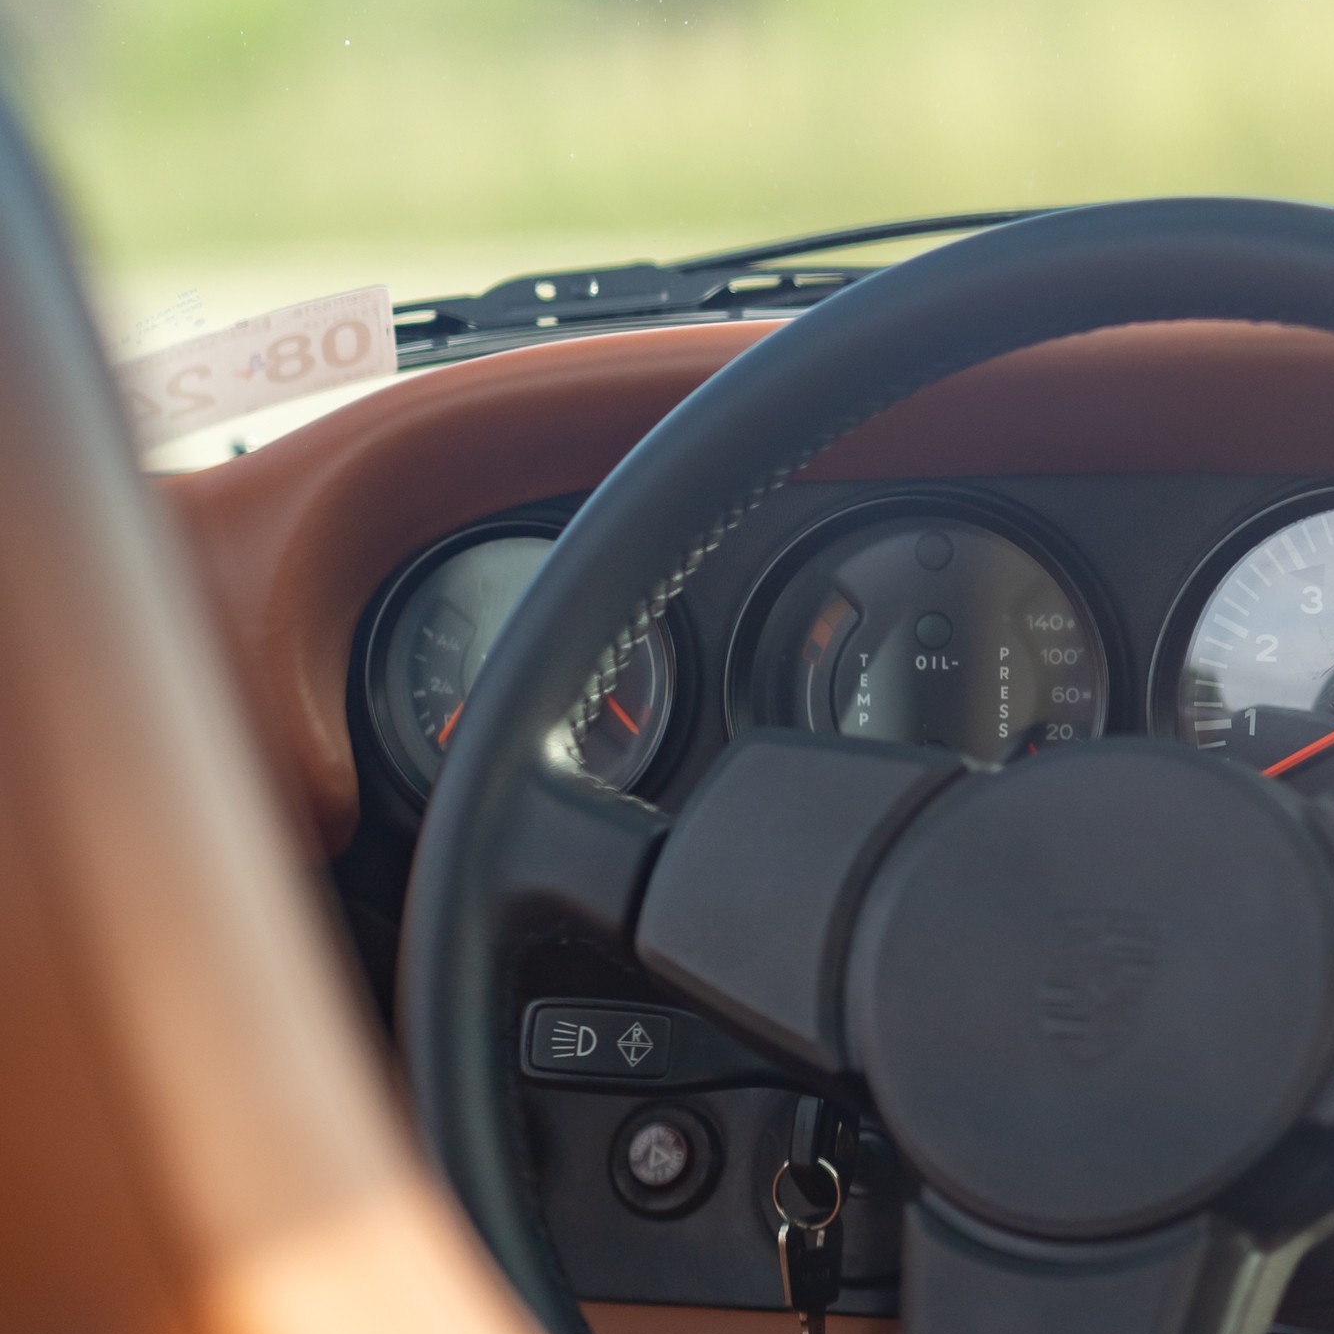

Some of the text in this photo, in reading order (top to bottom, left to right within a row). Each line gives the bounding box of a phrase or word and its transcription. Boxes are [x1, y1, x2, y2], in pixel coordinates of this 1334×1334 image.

[1300, 585, 1323, 614] 3
[1027, 615, 1063, 631] 140
[1040, 648, 1078, 665] 100
[1255, 634, 1279, 662] 2
[857, 654, 870, 727] TEMP
[999, 647, 1010, 739] PRESS
[1052, 687, 1079, 704] 60
[1244, 708, 1257, 736] 1
[1046, 723, 1073, 740] 20
[632, 1028, 642, 1042] R
[630, 1047, 638, 1061] L
